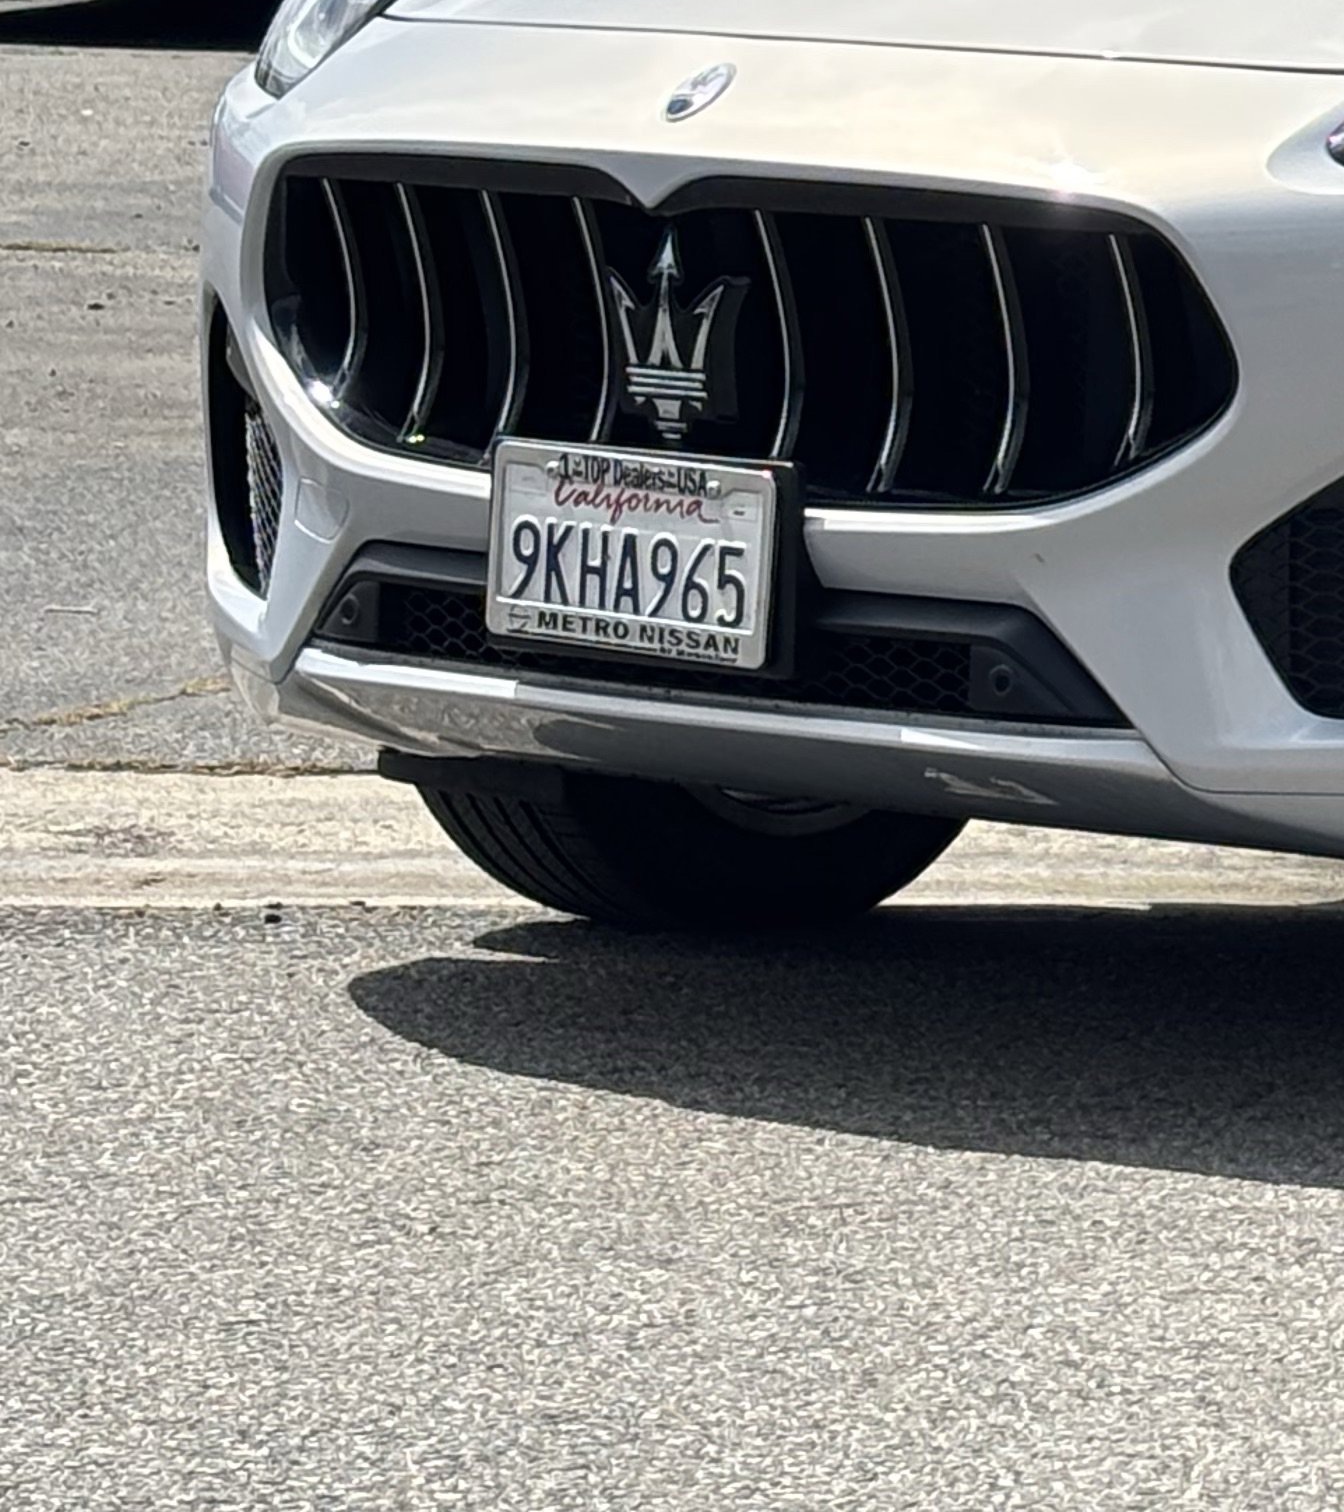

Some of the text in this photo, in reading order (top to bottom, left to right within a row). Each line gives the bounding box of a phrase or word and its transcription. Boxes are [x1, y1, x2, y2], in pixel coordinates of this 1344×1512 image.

[583, 455, 610, 485] TOP
[612, 458, 667, 491] Dealers
[679, 468, 708, 497] USA
[553, 481, 719, 525] California
[510, 516, 748, 630] 9KHA965
[536, 610, 629, 639] METRO
[639, 626, 740, 657] NISSAN
